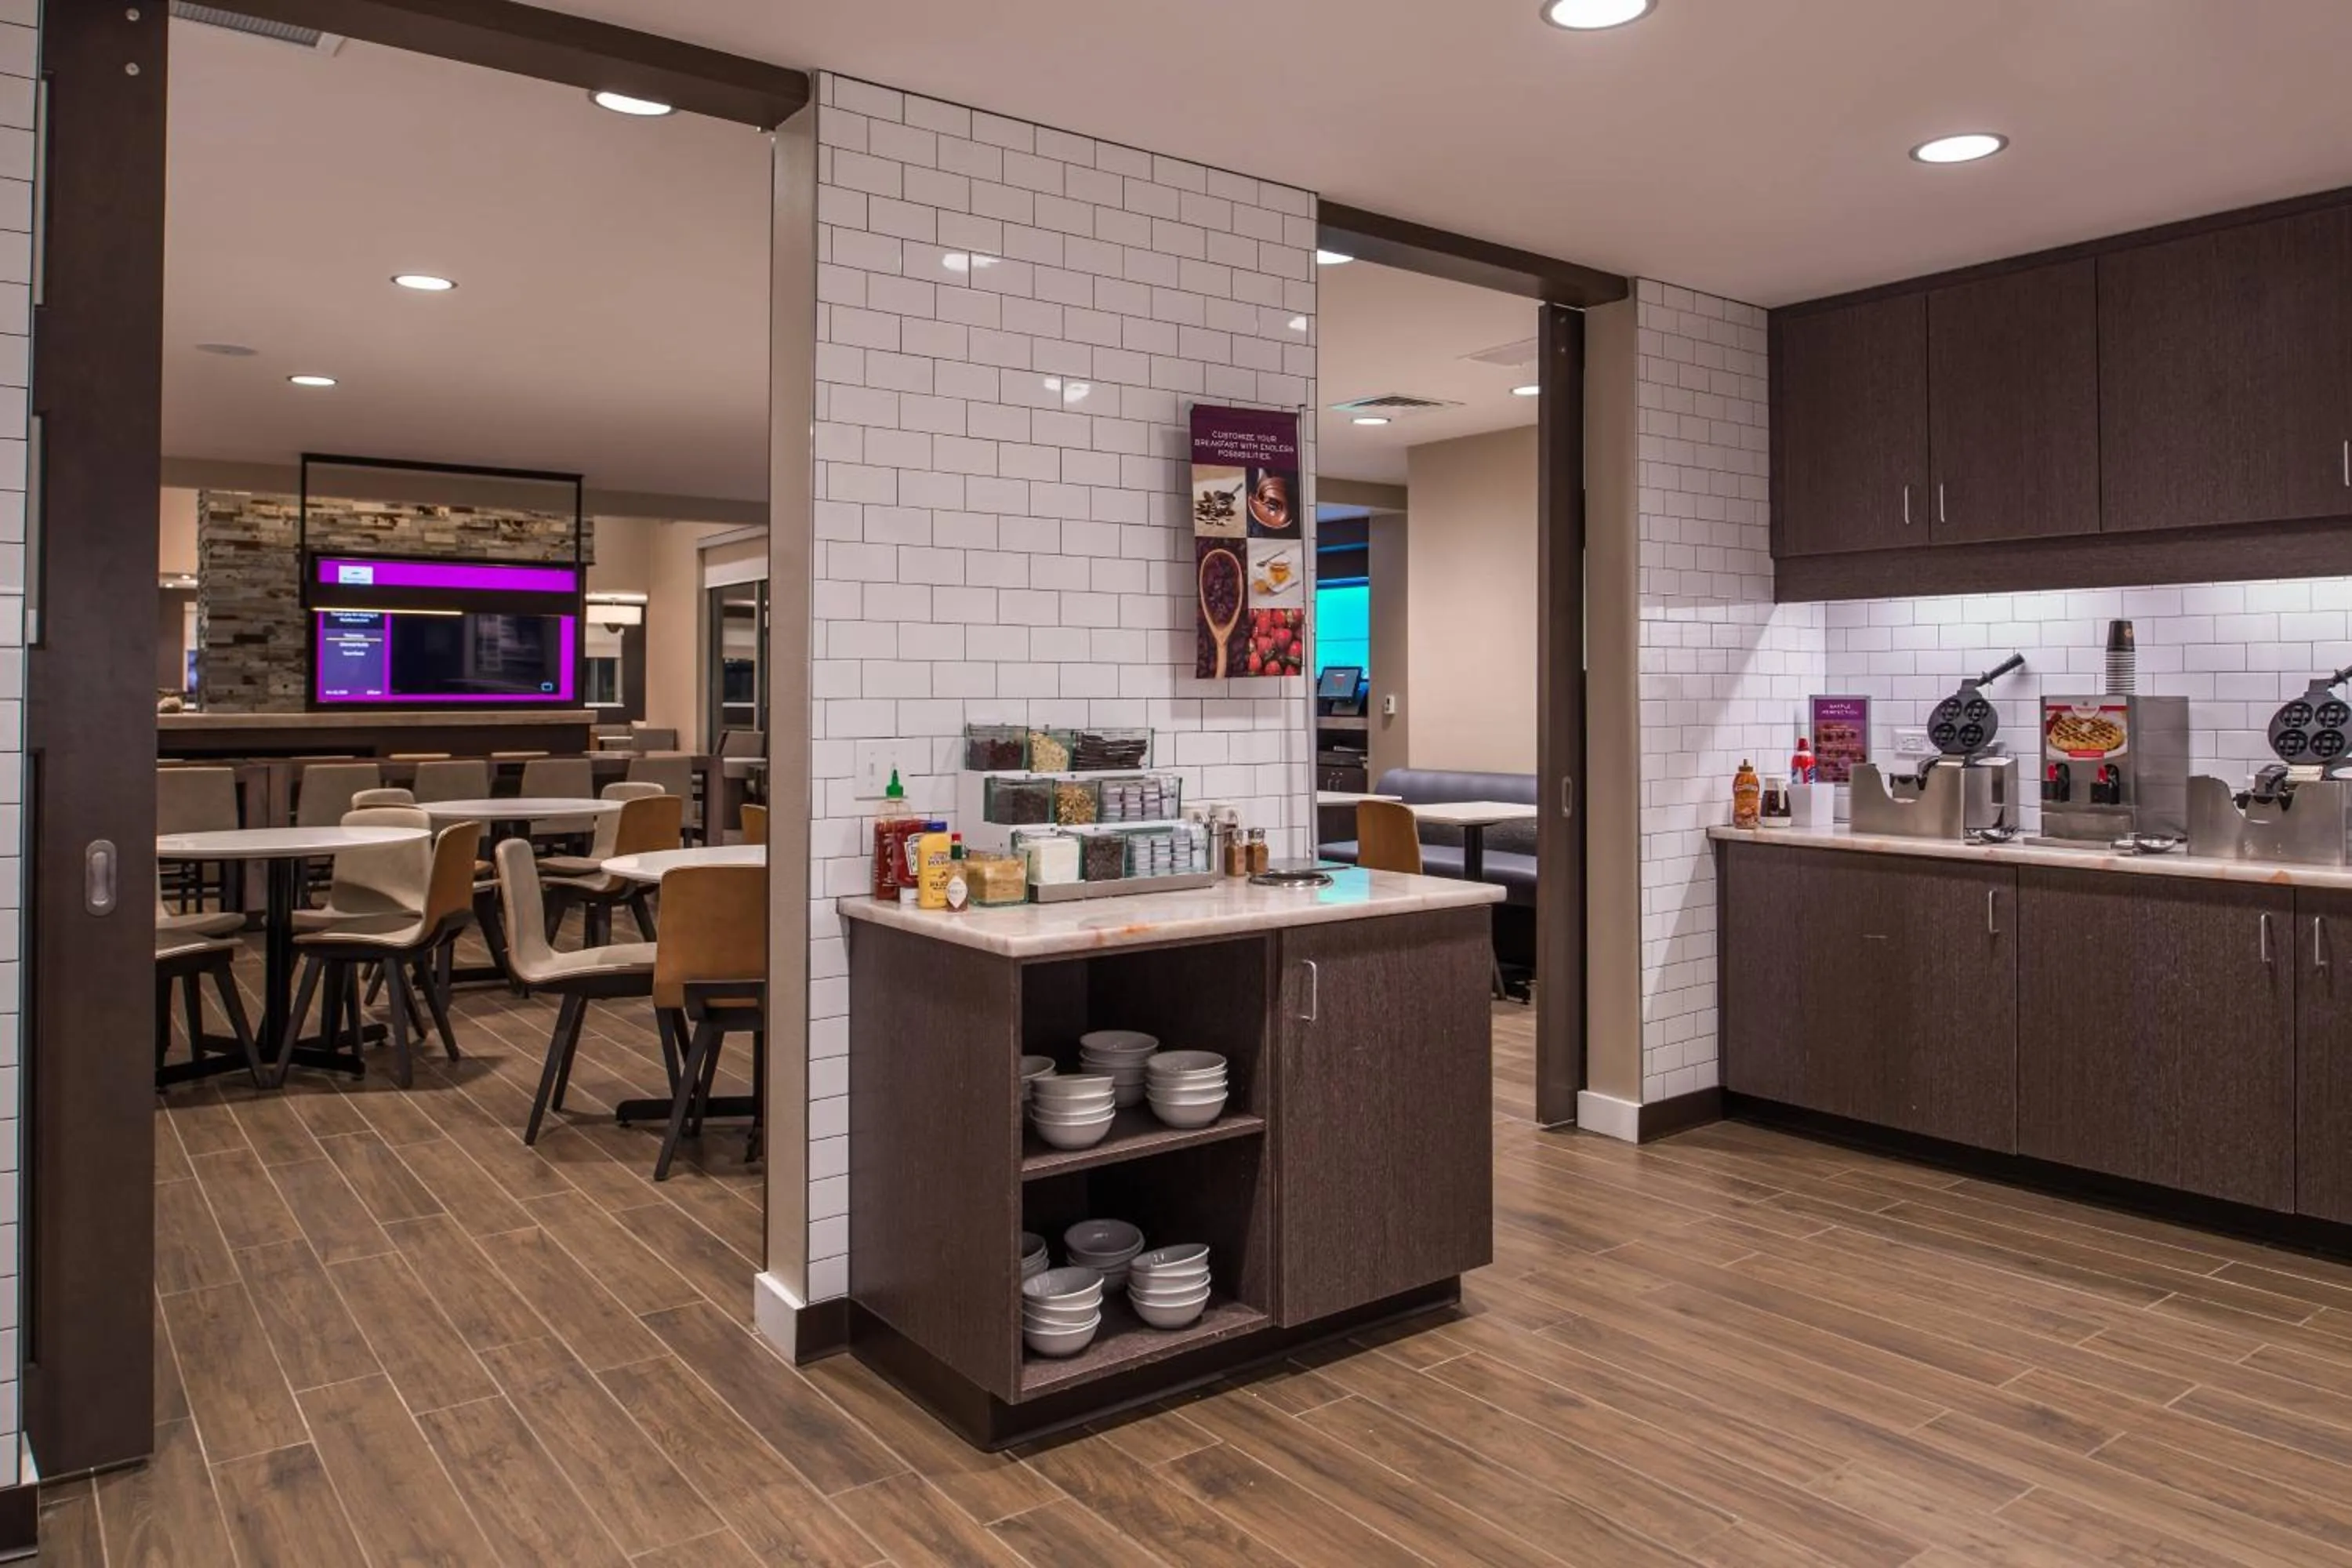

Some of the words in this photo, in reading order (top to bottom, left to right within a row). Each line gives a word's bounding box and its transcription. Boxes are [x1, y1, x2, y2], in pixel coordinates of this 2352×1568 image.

[1211, 430, 1255, 441] CUSTOMIZE
[1257, 434, 1277, 443] YOUR
[1194, 439, 1239, 449] BREAKFAST
[1260, 444, 1294, 453] ENDLESS
